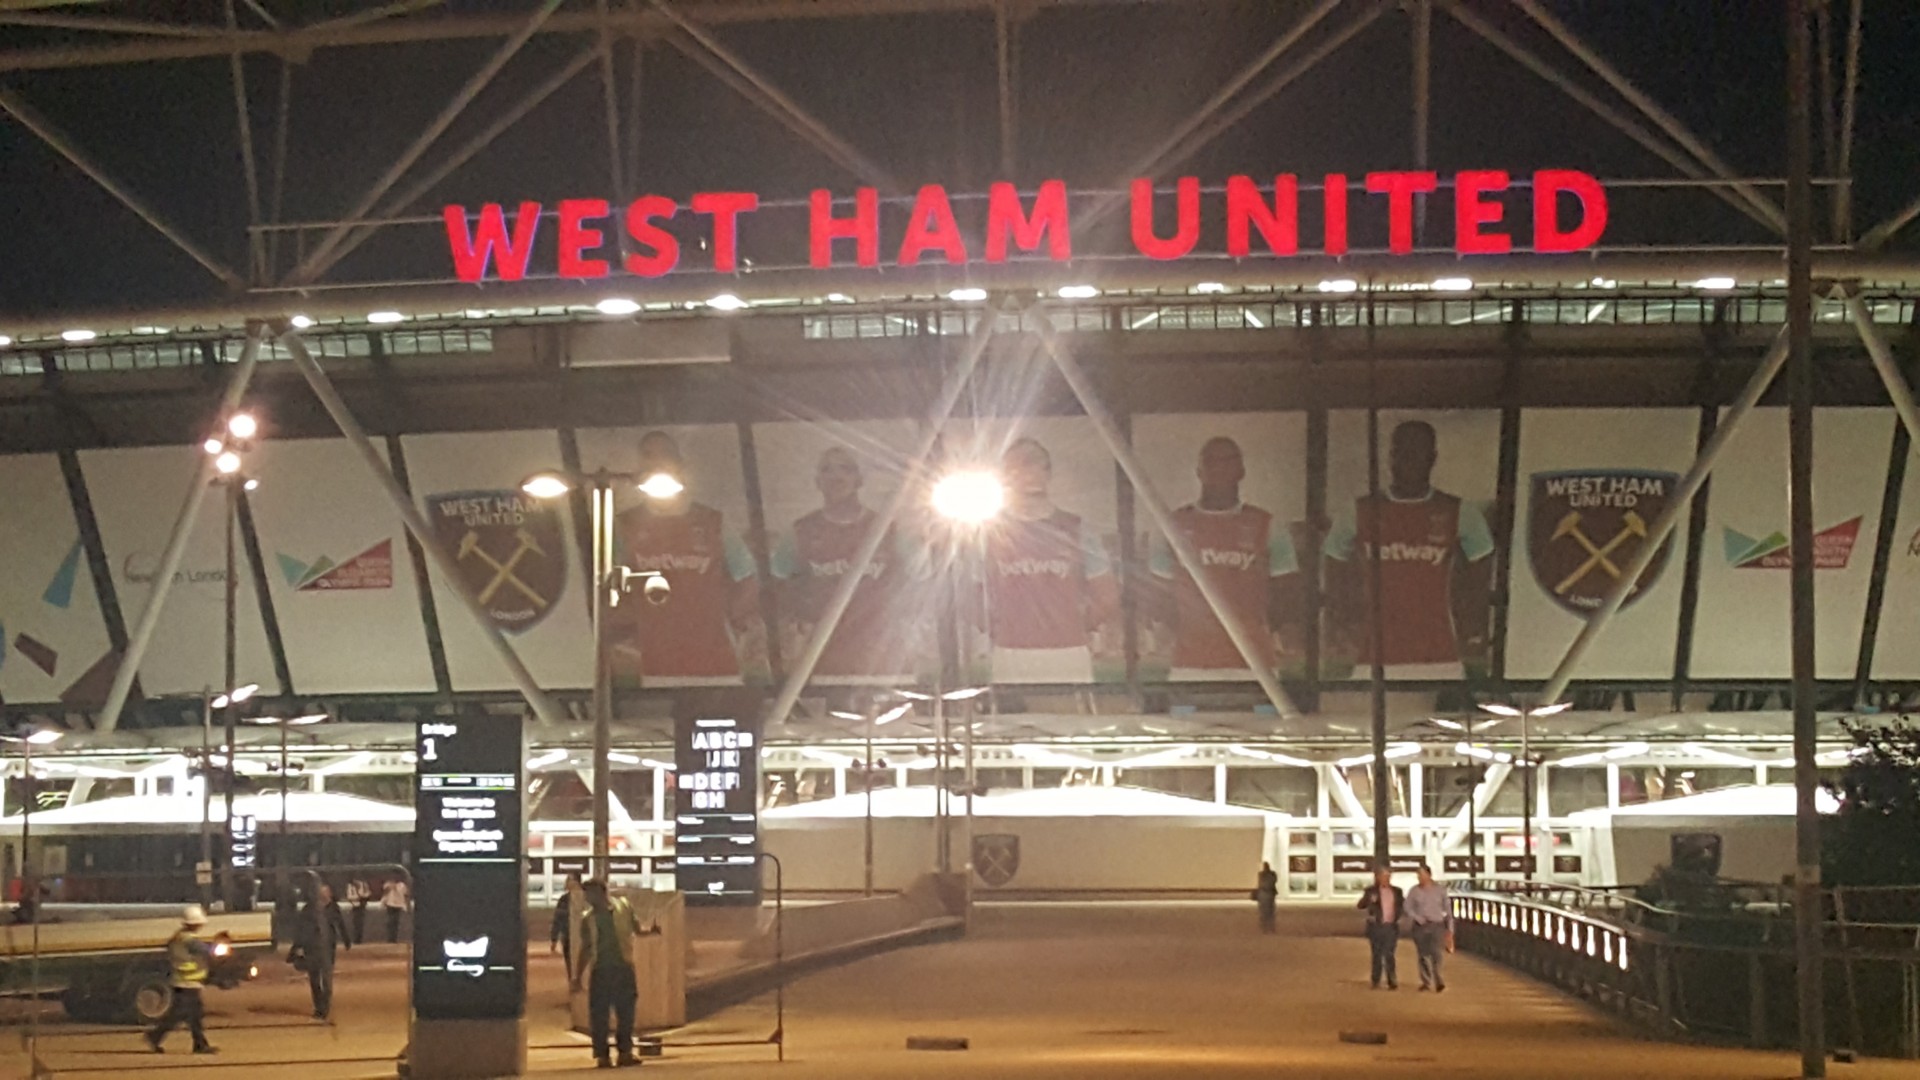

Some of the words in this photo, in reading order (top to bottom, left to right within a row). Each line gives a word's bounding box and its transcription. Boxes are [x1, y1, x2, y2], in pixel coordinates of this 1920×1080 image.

[443, 191, 760, 283] WEST
[808, 178, 1071, 270] HAM
[1129, 169, 1607, 260] UNITED
[1546, 477, 1605, 496] WEST
[1610, 477, 1664, 495] HAM
[440, 498, 493, 517] WEST
[496, 496, 544, 514] HAM
[1569, 494, 1638, 508] UNITED
[464, 513, 525, 527] UNITED
[1200, 548, 1257, 571] tway
[422, 738, 438, 760] 1
